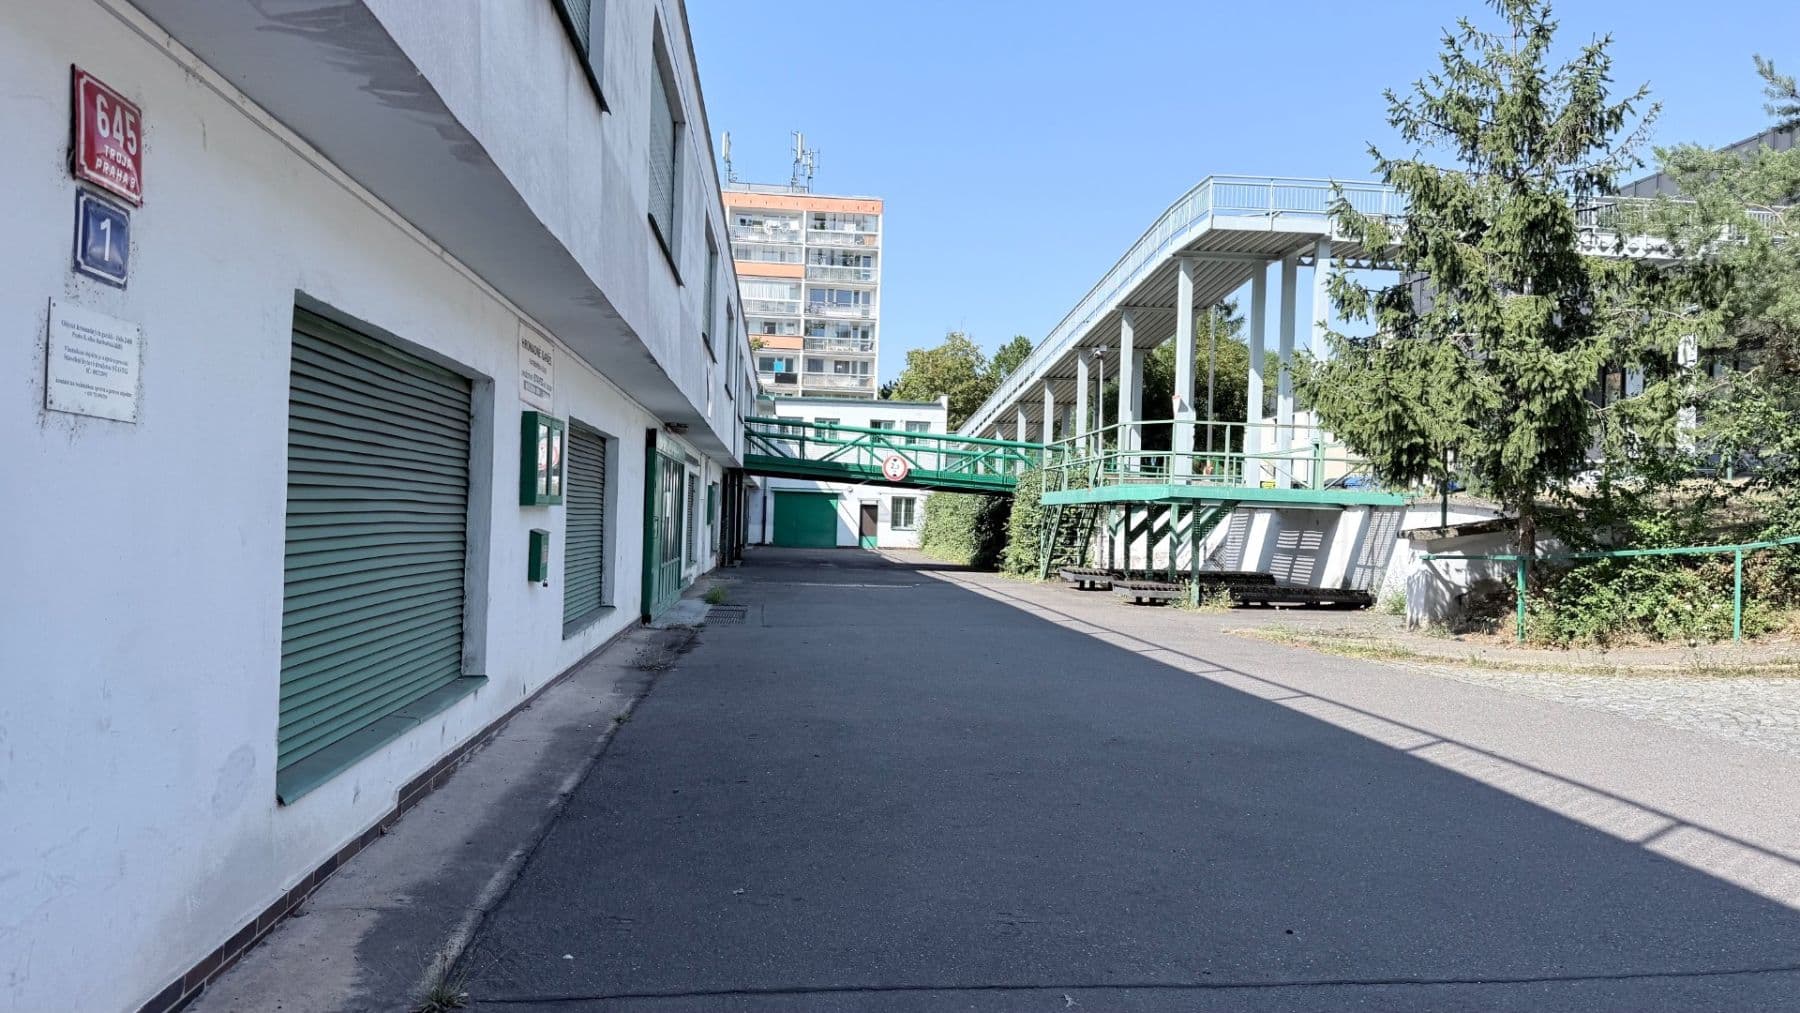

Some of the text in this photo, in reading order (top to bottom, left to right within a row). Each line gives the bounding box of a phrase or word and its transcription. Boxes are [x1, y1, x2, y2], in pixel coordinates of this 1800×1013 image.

[96, 94, 137, 156] 645
[95, 157, 129, 185] PRAHA
[104, 144, 133, 171] TROJA
[100, 218, 111, 262] 1
